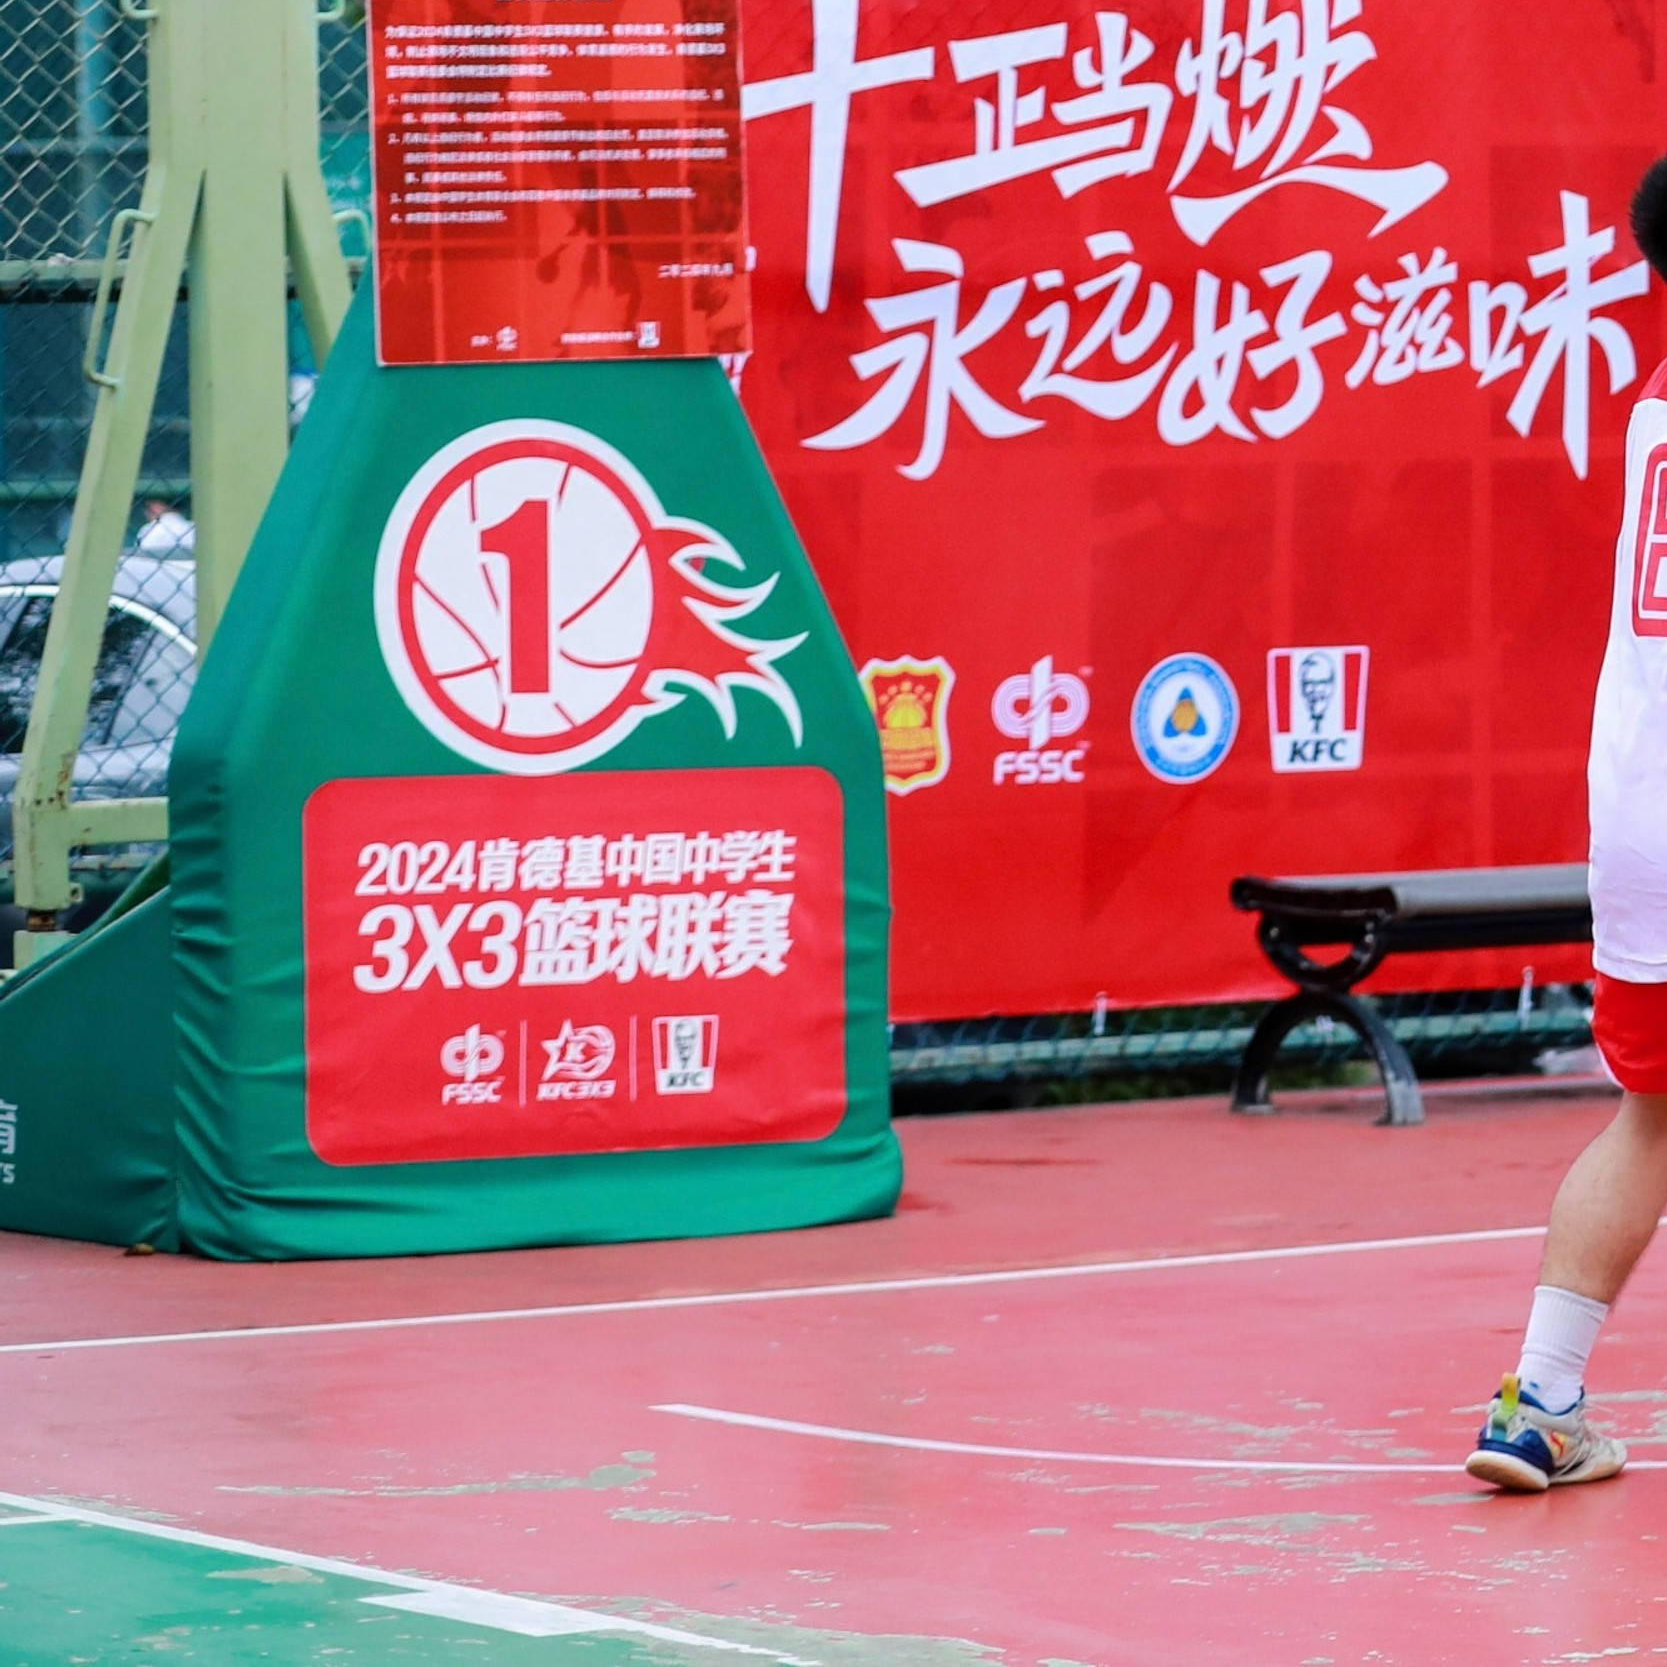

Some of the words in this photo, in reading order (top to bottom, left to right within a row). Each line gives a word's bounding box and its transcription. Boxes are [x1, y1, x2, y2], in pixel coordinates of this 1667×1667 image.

[802, 192, 1649, 479] 永远好滋味
[481, 498, 551, 694] 1
[994, 751, 1084, 785] FSSC
[1289, 739, 1347, 764] KFC
[355, 830, 796, 894] 2024肯德基中国中学生
[353, 891, 794, 993] 3X3篮球联赛
[442, 1081, 501, 1105] FSSC
[666, 1070, 707, 1089] KFC
